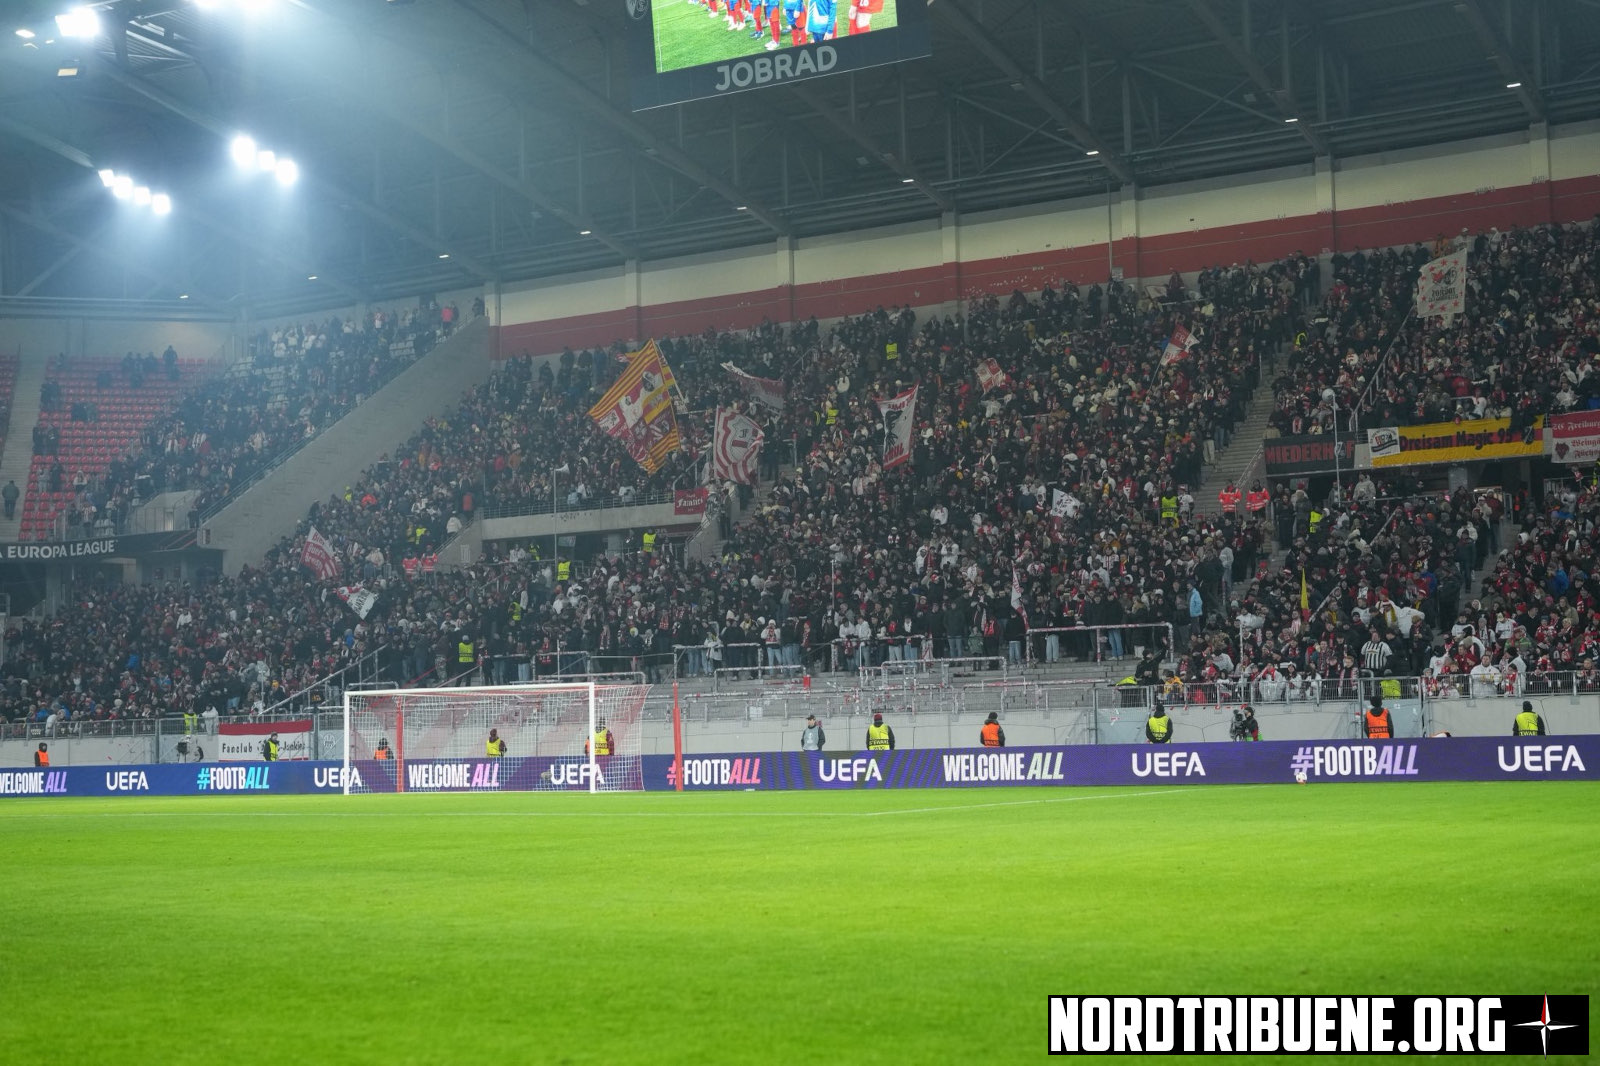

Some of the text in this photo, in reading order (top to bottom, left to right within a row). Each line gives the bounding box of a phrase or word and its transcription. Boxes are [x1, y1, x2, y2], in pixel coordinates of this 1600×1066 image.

[715, 46, 837, 91] JOBRAD
[1400, 433, 1453, 452] Dreisam
[1456, 429, 1493, 450] Magic
[7, 545, 67, 559] EUROPA
[70, 540, 115, 556] LEAGUE
[222, 743, 253, 753] Fanclub
[1498, 744, 1586, 772] UEFA
[666, 758, 760, 786] #FOOTBALL
[818, 759, 882, 782] UEFA
[943, 752, 1064, 781] WELCOME ALL
[1131, 752, 1206, 777] UEFA
[1290, 745, 1419, 776] #FOOTBALL
[45, 771, 67, 792] ALL
[106, 771, 149, 790] UEFA
[197, 767, 270, 792] #FOOTBALL
[314, 767, 362, 788] UEFA
[408, 763, 500, 788] WELCOME ALL
[550, 763, 605, 785] UEFA
